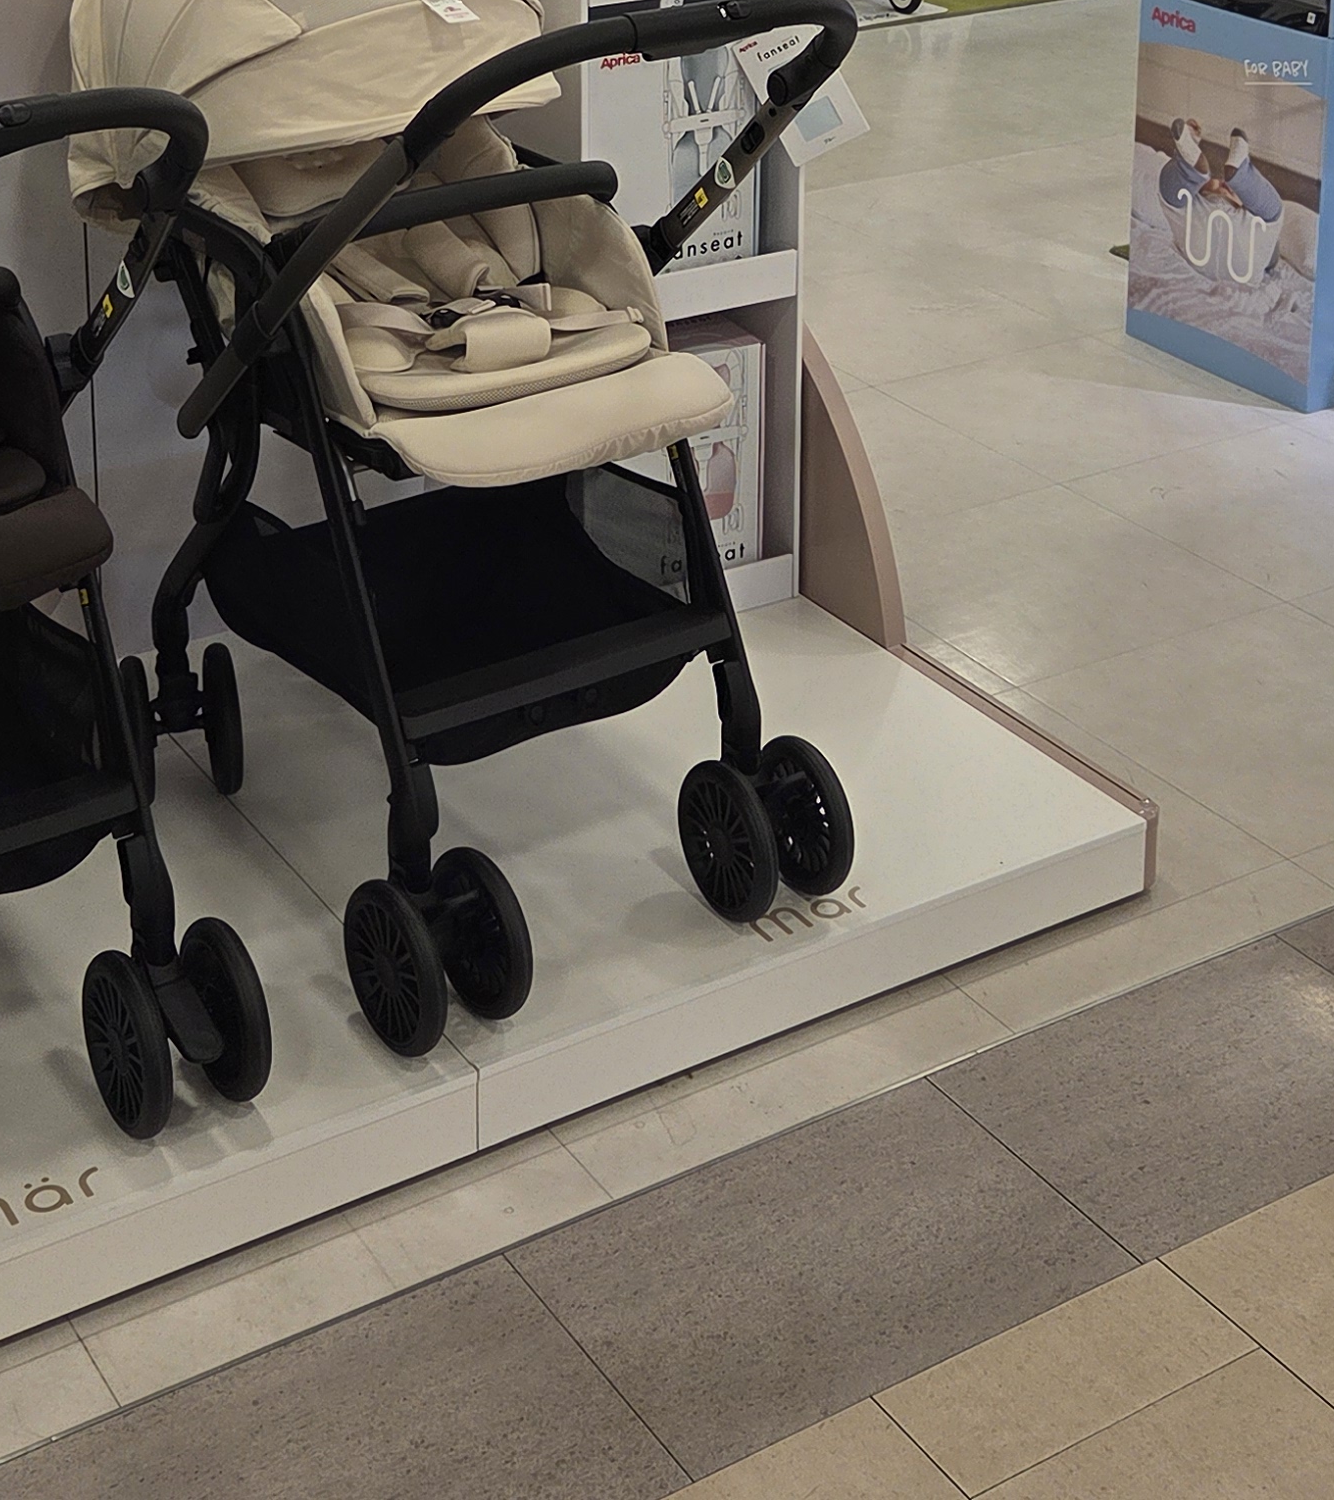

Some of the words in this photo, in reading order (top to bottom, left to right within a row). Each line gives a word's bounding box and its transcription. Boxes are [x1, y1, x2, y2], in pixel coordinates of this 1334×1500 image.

[1152, 6, 1196, 33] Aprica
[757, 35, 801, 62] fanseat
[600, 52, 641, 70] Aprica
[1244, 59, 1268, 77] FOR
[1272, 59, 1309, 78] BABY
